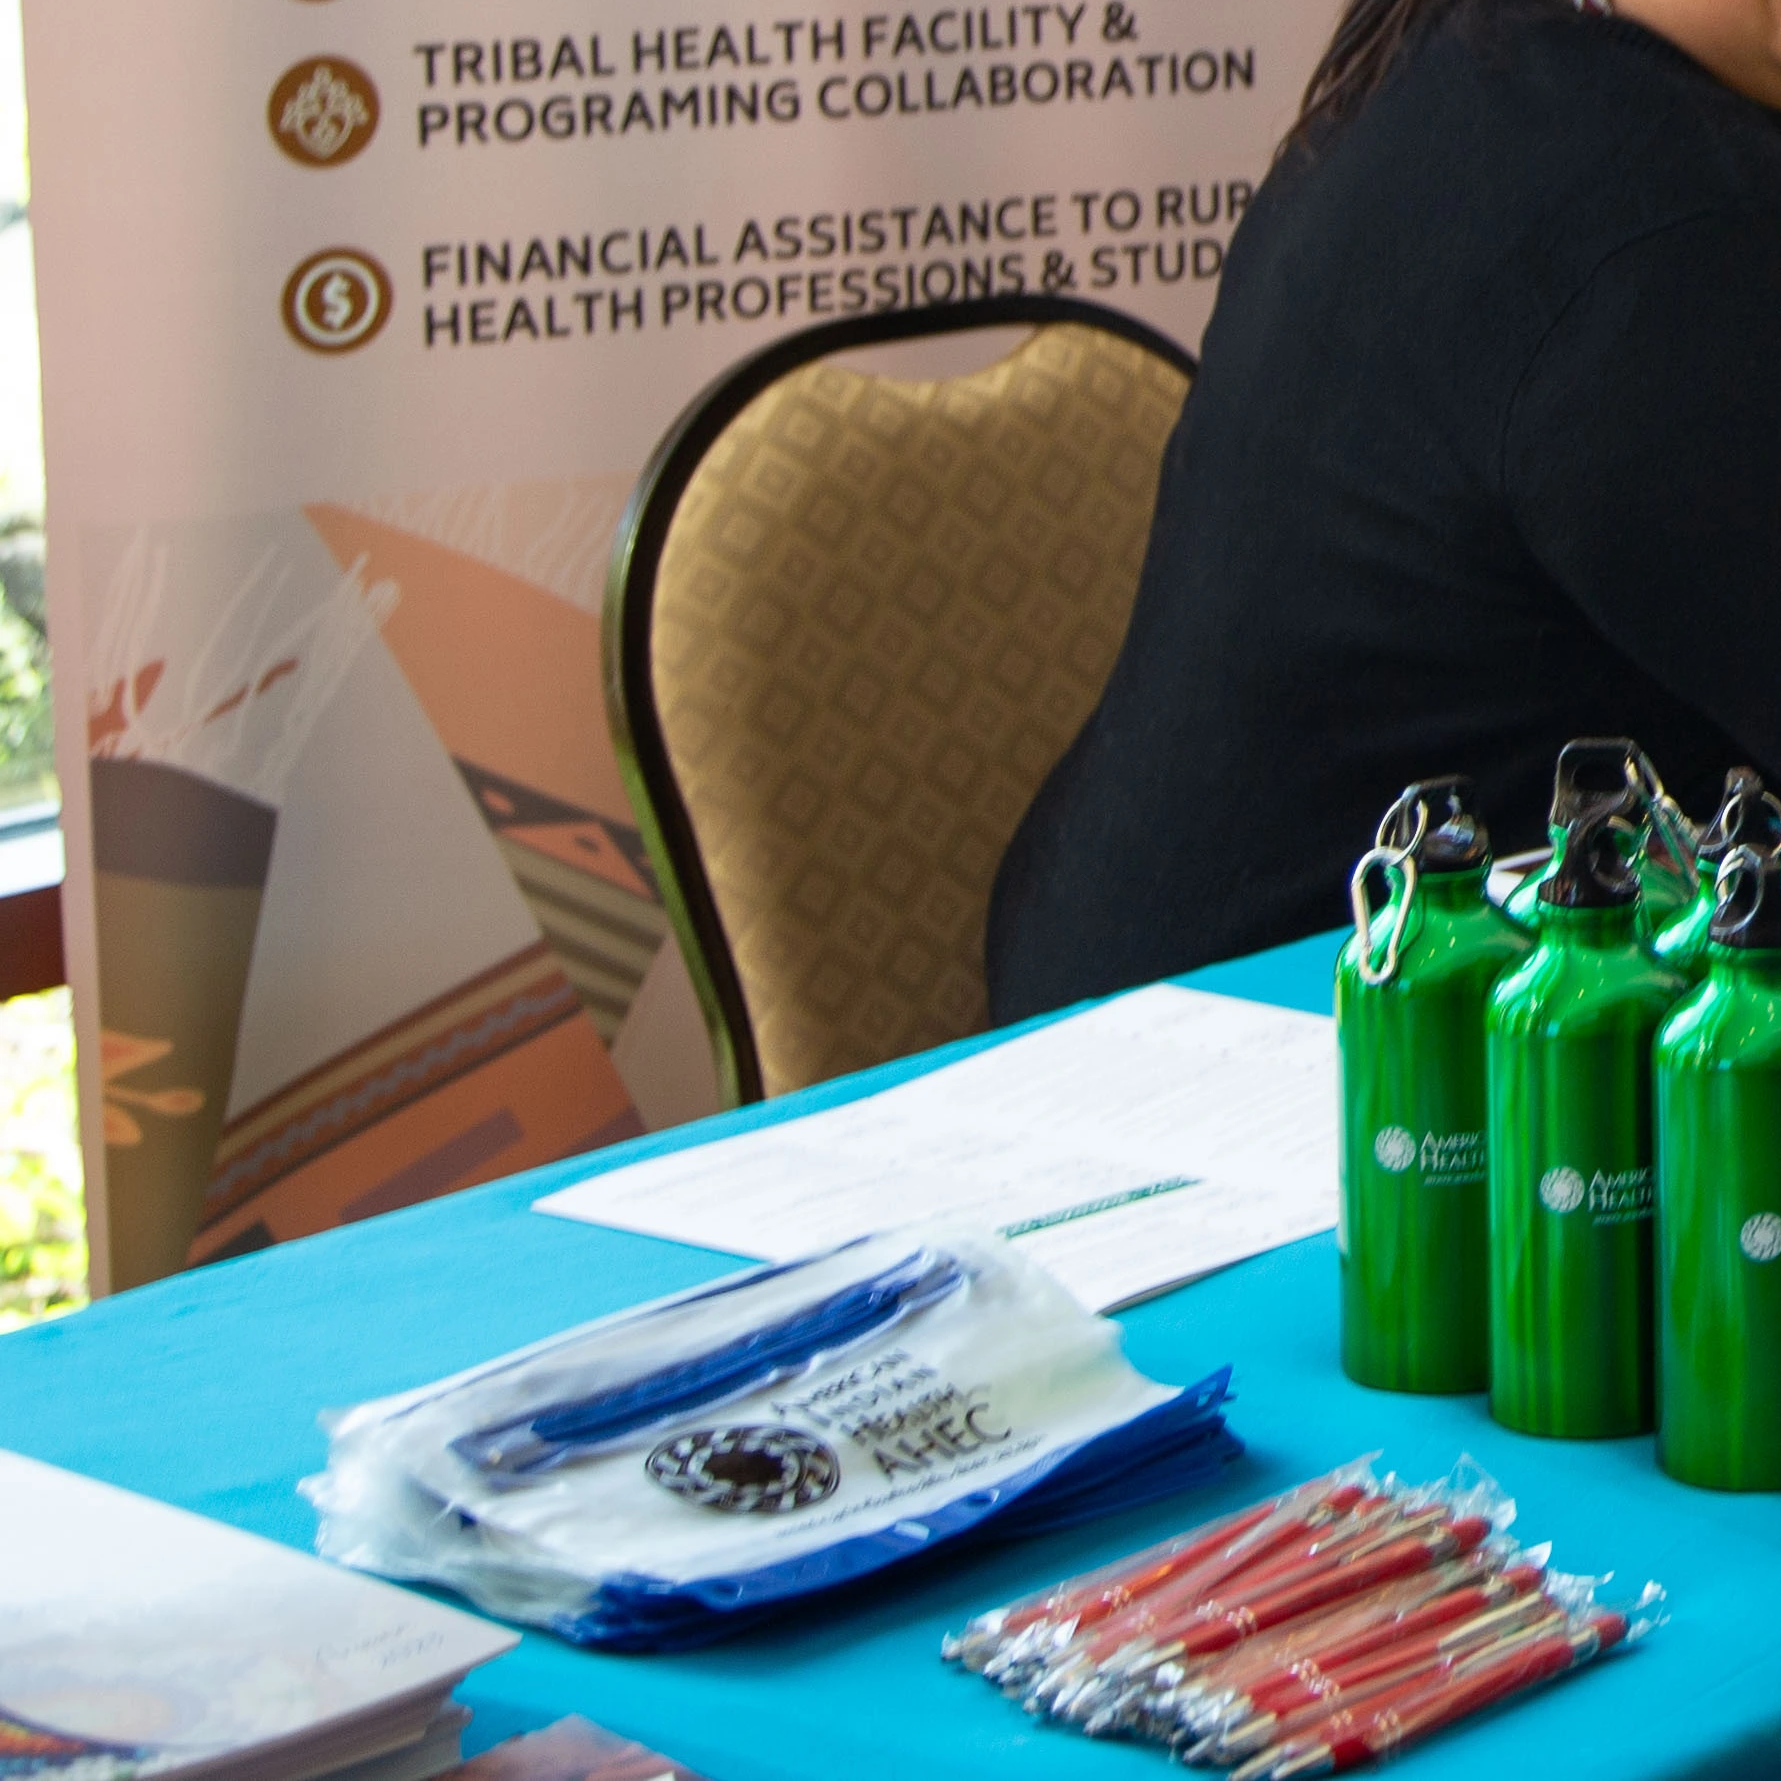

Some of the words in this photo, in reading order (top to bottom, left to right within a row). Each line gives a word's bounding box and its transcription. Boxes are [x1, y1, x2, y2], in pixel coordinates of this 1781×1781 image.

[415, 35, 614, 87] TRIBAL
[633, 19, 845, 73] HEALTH
[862, 4, 1085, 58] FACILITY
[1102, 1, 1138, 43] &
[419, 80, 800, 147] PROGRAMING
[818, 49, 1254, 120] COLLABORATION
[423, 225, 718, 287] FINANCIAL
[734, 196, 1057, 263] ASSISTANCE
[1072, 190, 1141, 233] TO
[425, 288, 644, 347] HEALTH
[662, 252, 1026, 325] PROFESSIONS
[1040, 248, 1076, 292] &
